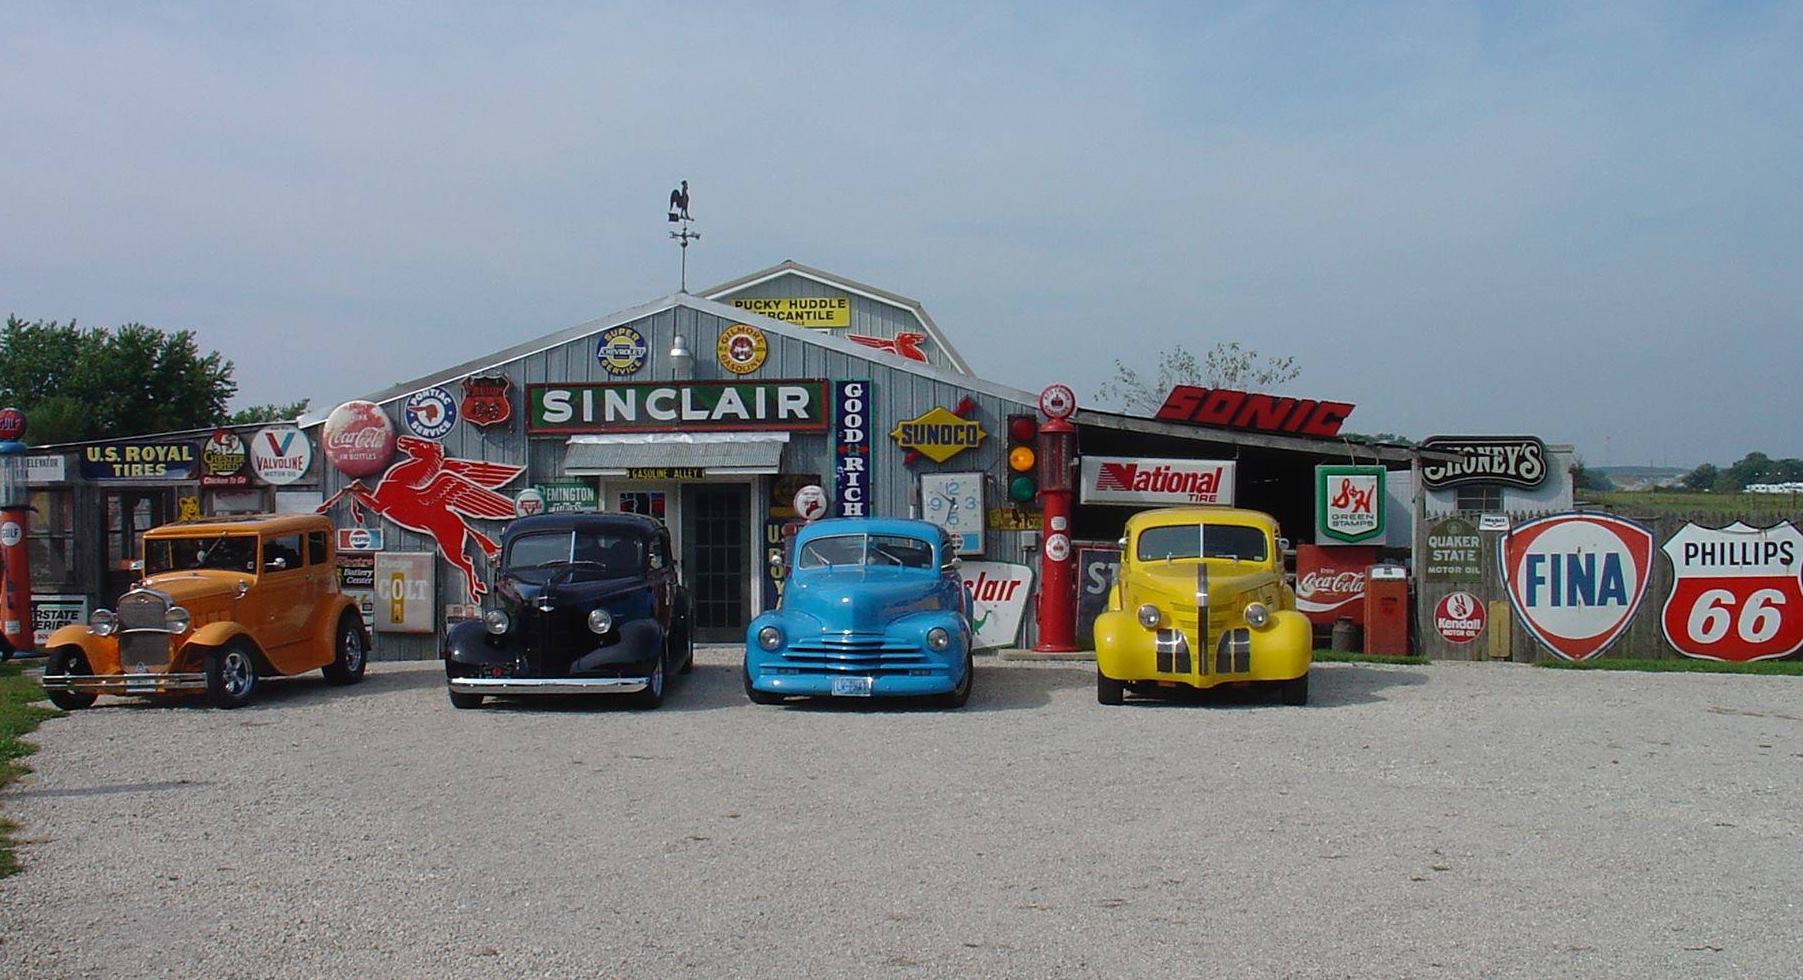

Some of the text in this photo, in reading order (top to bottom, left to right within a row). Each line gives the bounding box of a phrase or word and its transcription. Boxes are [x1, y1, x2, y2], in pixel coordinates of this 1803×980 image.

[789, 299, 846, 309] HUDDLE
[752, 310, 834, 321] RCANTILE
[605, 327, 640, 342] SUPER
[721, 326, 763, 345] GILMORE
[601, 358, 641, 375] SERVICE
[721, 353, 763, 372] GASOLINE
[410, 389, 452, 406] PONTIAC
[542, 387, 810, 423] SINCLAIR
[1154, 385, 1356, 438] SONIC
[410, 420, 452, 437] SERVICE
[901, 423, 977, 446] SUNOCO
[328, 427, 384, 449] Coca-Cola
[86, 446, 194, 462] U.S. ROYAL
[112, 464, 167, 477] TIRES
[256, 455, 303, 472] VALVOLINE
[632, 468, 698, 479] GASOLINE ALLEY
[1096, 462, 1223, 493] National
[945, 482, 960, 496] 12
[1331, 478, 1375, 513] S&H
[930, 497, 942, 511] 9
[965, 497, 977, 510] 3
[1187, 494, 1217, 503] TIRE
[1331, 513, 1375, 521] GREEN
[1331, 520, 1375, 528] STAMPS
[1428, 535, 1480, 548] QUAKER
[1432, 549, 1477, 561] STATE
[1685, 540, 1795, 567] PHILLIPS
[343, 567, 374, 579] Battery
[1427, 566, 1480, 574] MOTOR OIL
[346, 576, 373, 585] Center
[1301, 571, 1366, 598] Coca-Cola
[1526, 552, 1628, 608] FINA
[378, 577, 429, 601] COLT
[1438, 618, 1481, 630] Kendall
[1686, 588, 1787, 645] 66
[1443, 629, 1464, 637] MOTOR
